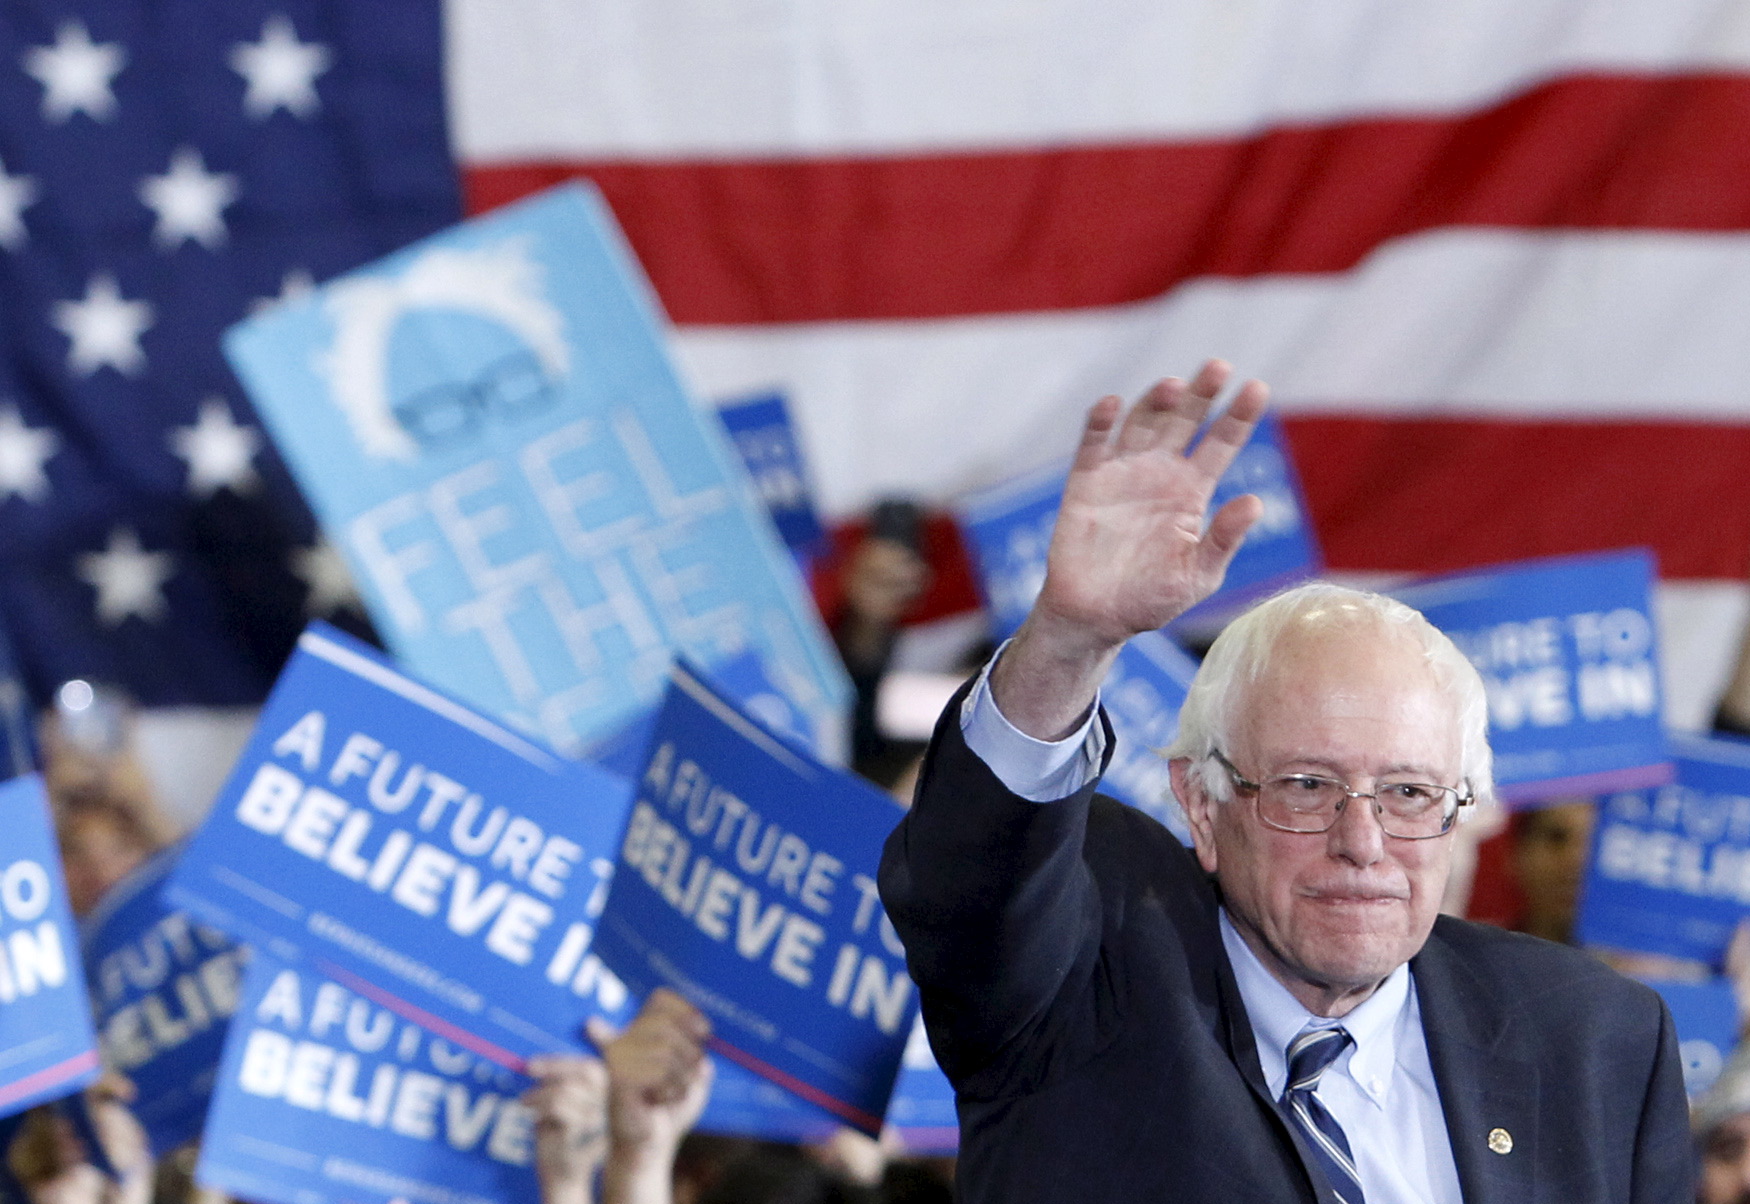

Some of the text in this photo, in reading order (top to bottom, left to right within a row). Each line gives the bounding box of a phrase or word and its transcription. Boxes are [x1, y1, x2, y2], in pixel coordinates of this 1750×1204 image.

[350, 407, 728, 633] FEEL
[444, 526, 750, 704] THE
[235, 762, 554, 967] BELIEVE
[273, 710, 326, 773] A
[328, 732, 584, 898] FUTURE
[665, 758, 845, 916] FUTURE
[256, 969, 301, 1029] A
[622, 799, 827, 988] BELIEVE
[826, 942, 914, 1037] IN
[237, 1028, 538, 1167] BELIEVE
